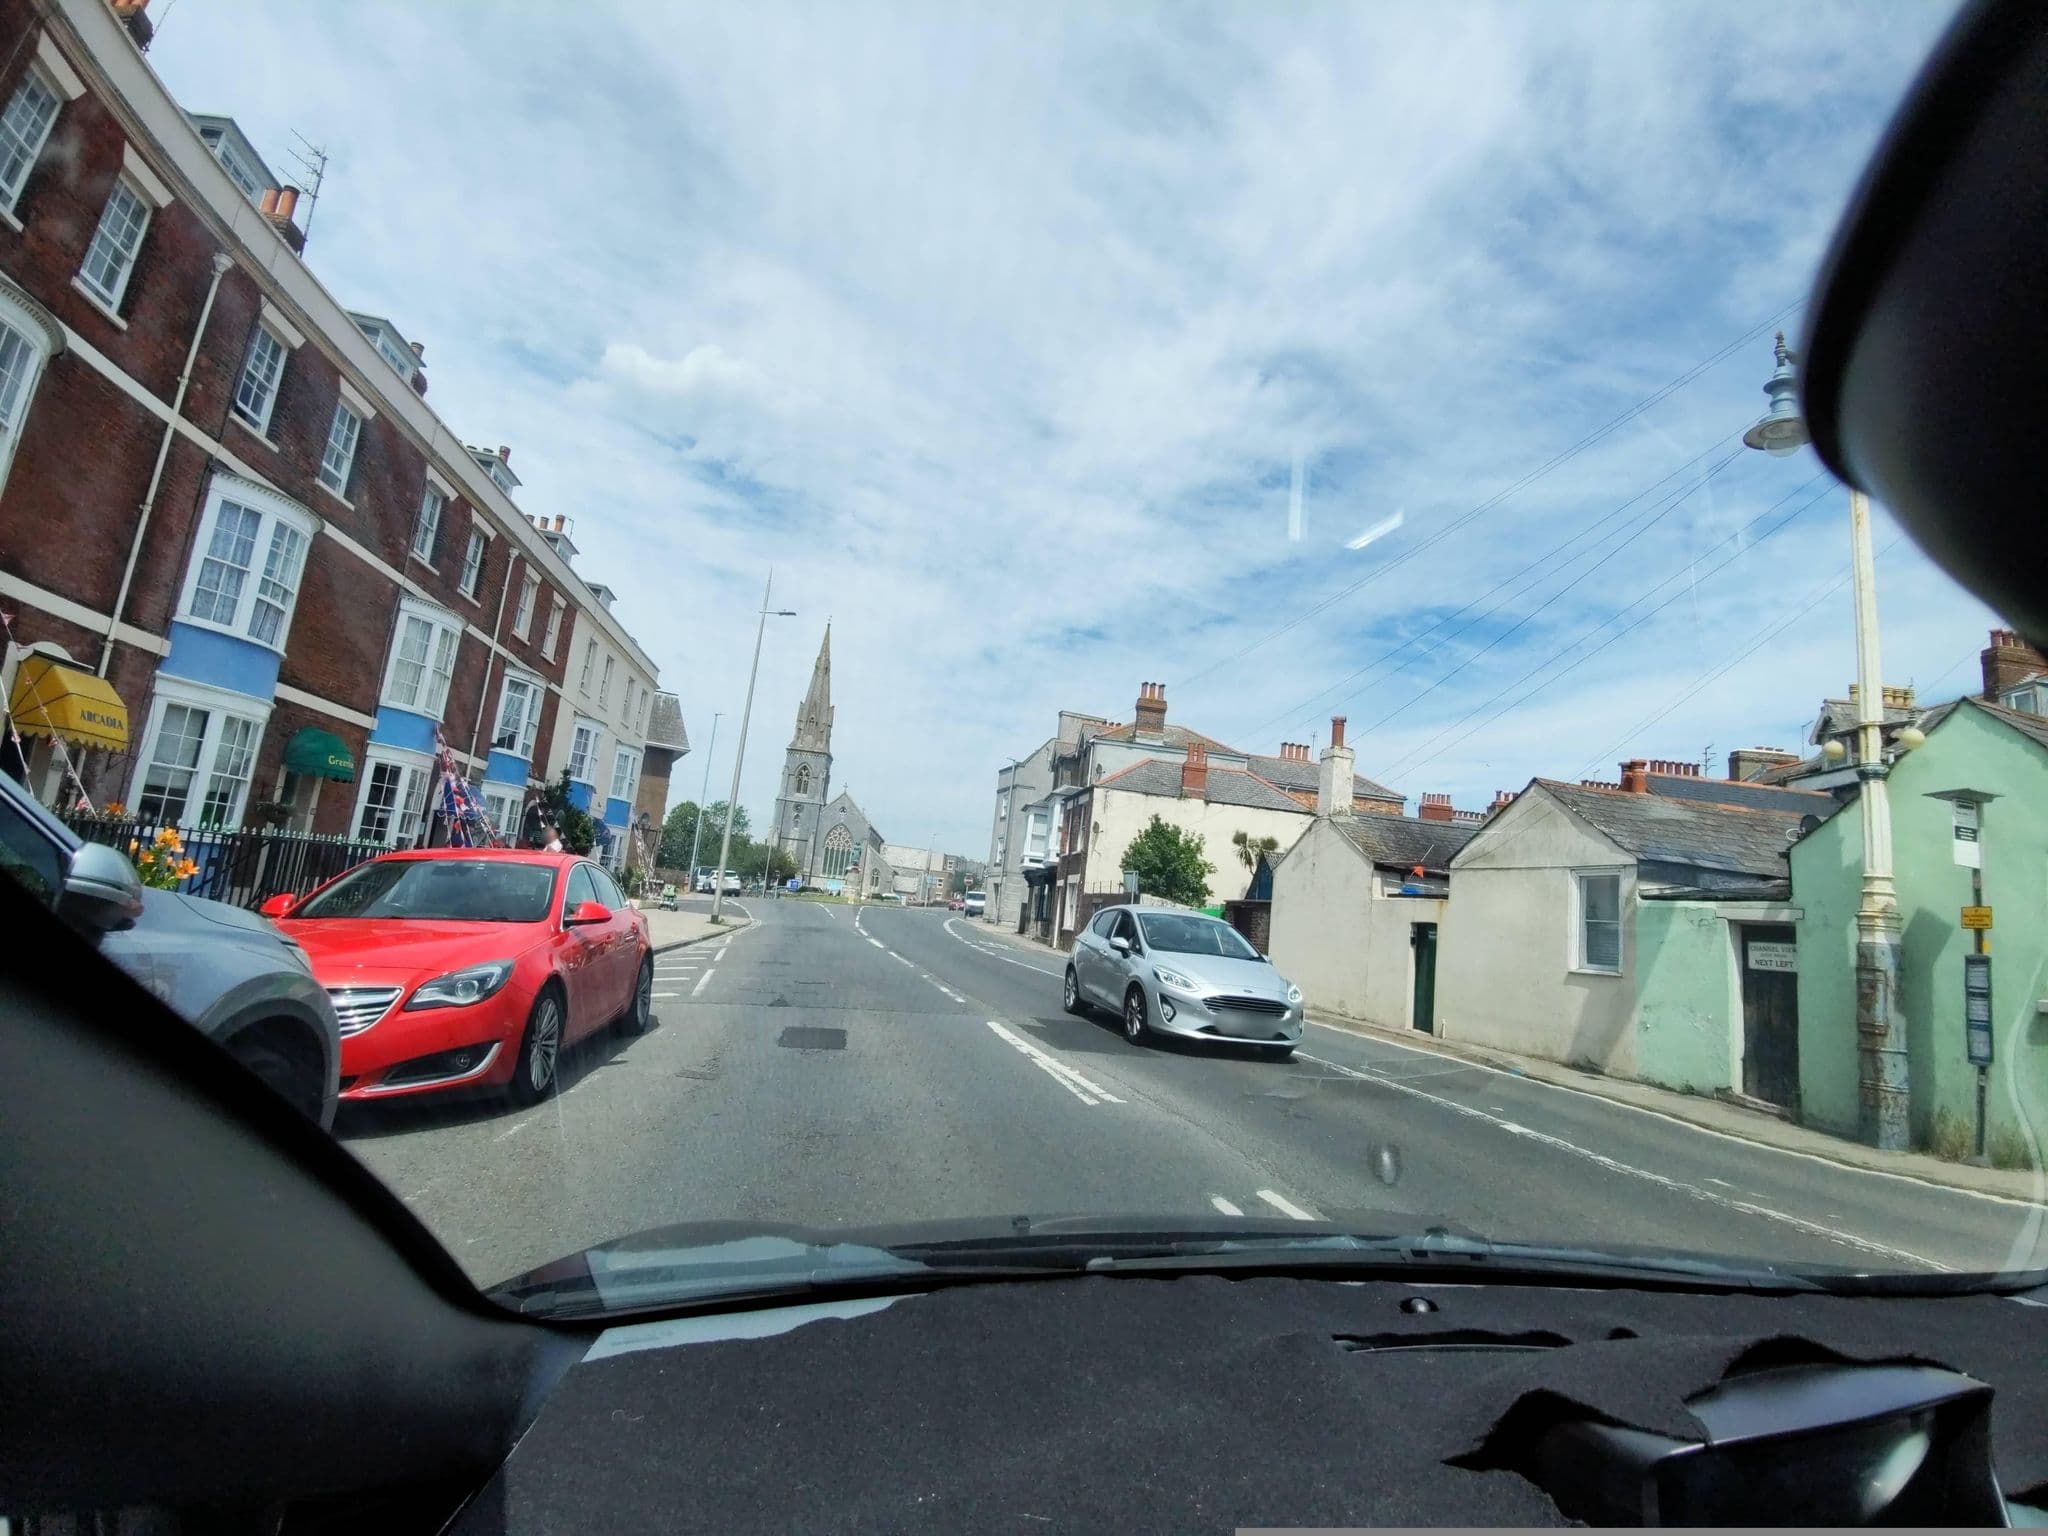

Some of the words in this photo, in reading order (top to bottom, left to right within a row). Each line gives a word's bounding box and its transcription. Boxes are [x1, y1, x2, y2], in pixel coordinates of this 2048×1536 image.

[80, 709, 124, 730] ARCADIA
[1750, 944, 1780, 953] CHANNEL
[1754, 959, 1773, 967] NEXT
[1775, 960, 1794, 968] LEFT
